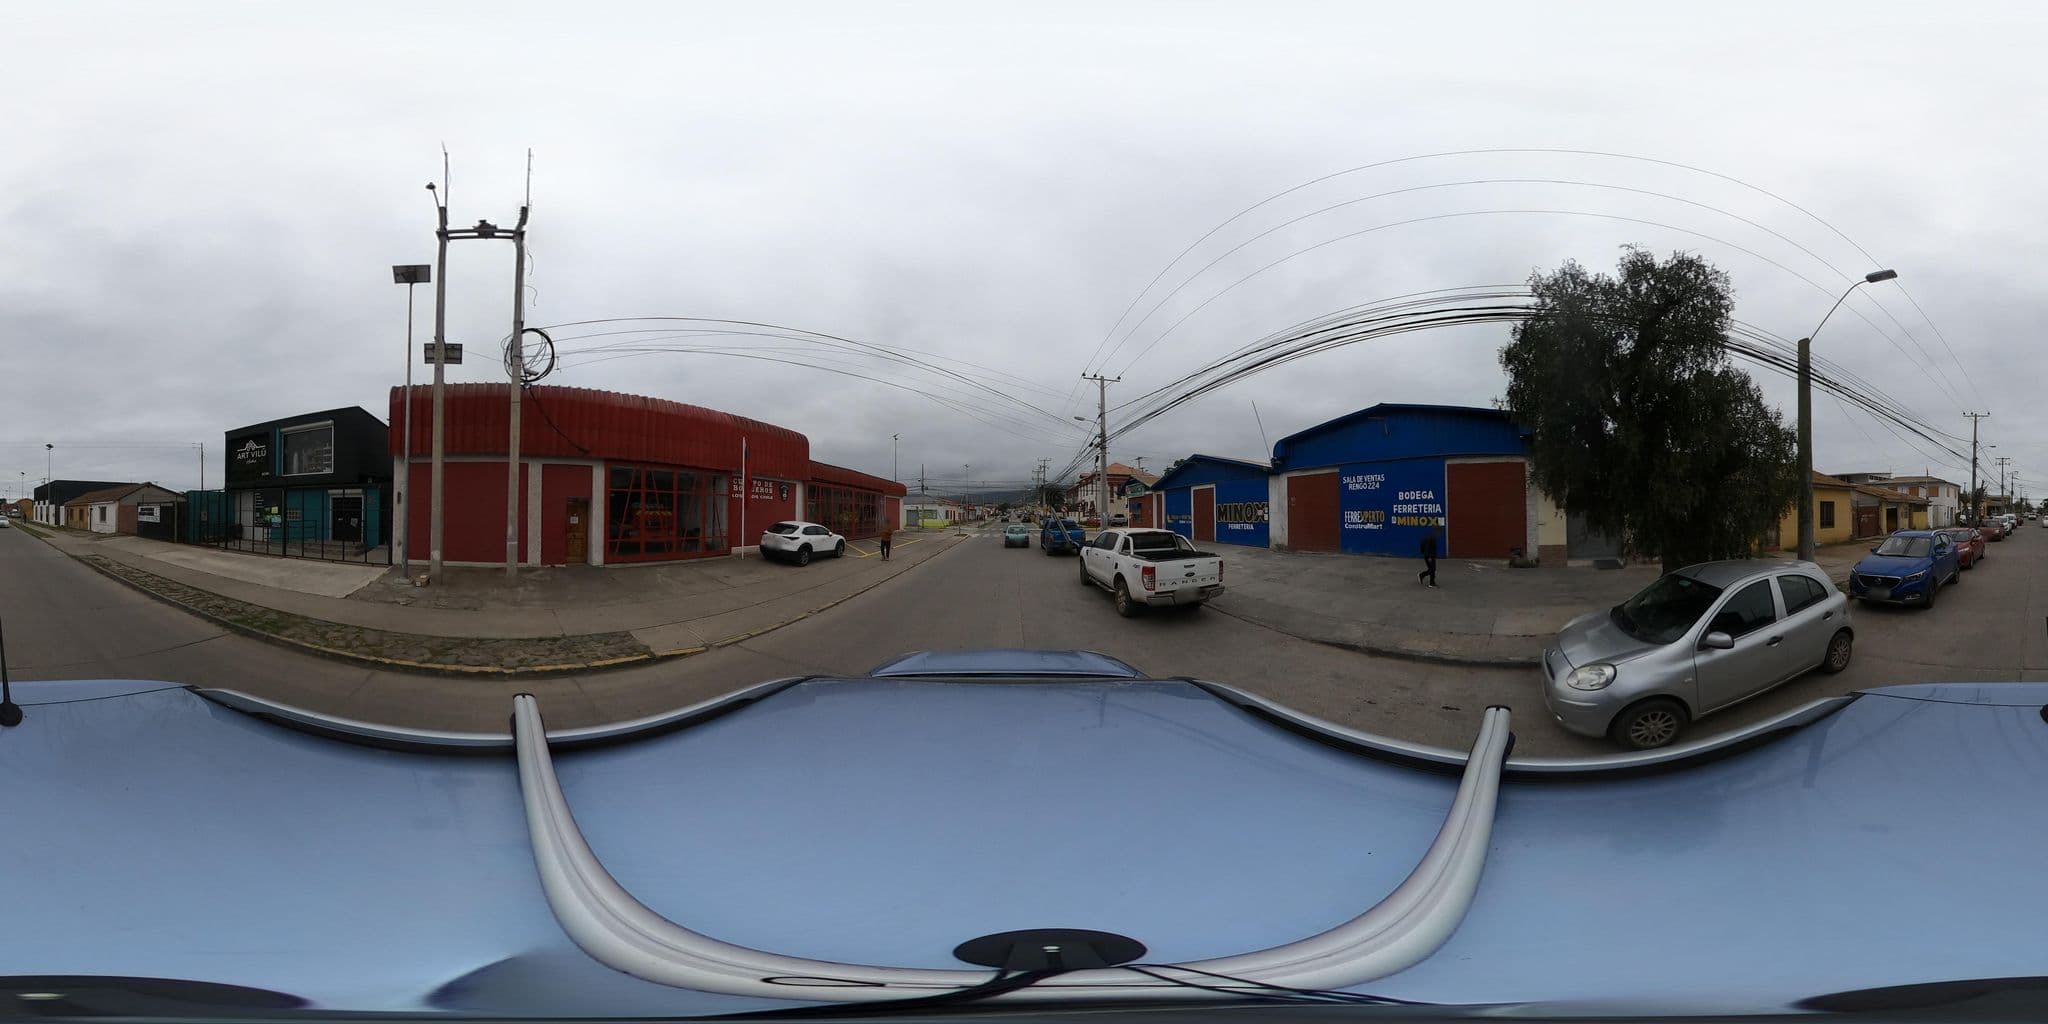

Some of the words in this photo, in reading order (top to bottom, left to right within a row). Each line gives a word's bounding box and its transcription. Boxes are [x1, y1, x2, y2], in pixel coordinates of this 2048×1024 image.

[238, 451, 249, 460] ART
[733, 478, 762, 487] CUPO
[1342, 476, 1356, 484] SALA
[1356, 475, 1363, 483] DE
[1363, 473, 1385, 482] VENTAS
[733, 485, 773, 494] BOEROS
[1348, 482, 1367, 490] RENGO
[1367, 482, 1380, 490] 224
[1398, 490, 1434, 501] BODEGA
[1216, 502, 1268, 523] MINOX
[1393, 503, 1442, 513] FERRETERIA
[1397, 516, 1438, 526] MINOX
